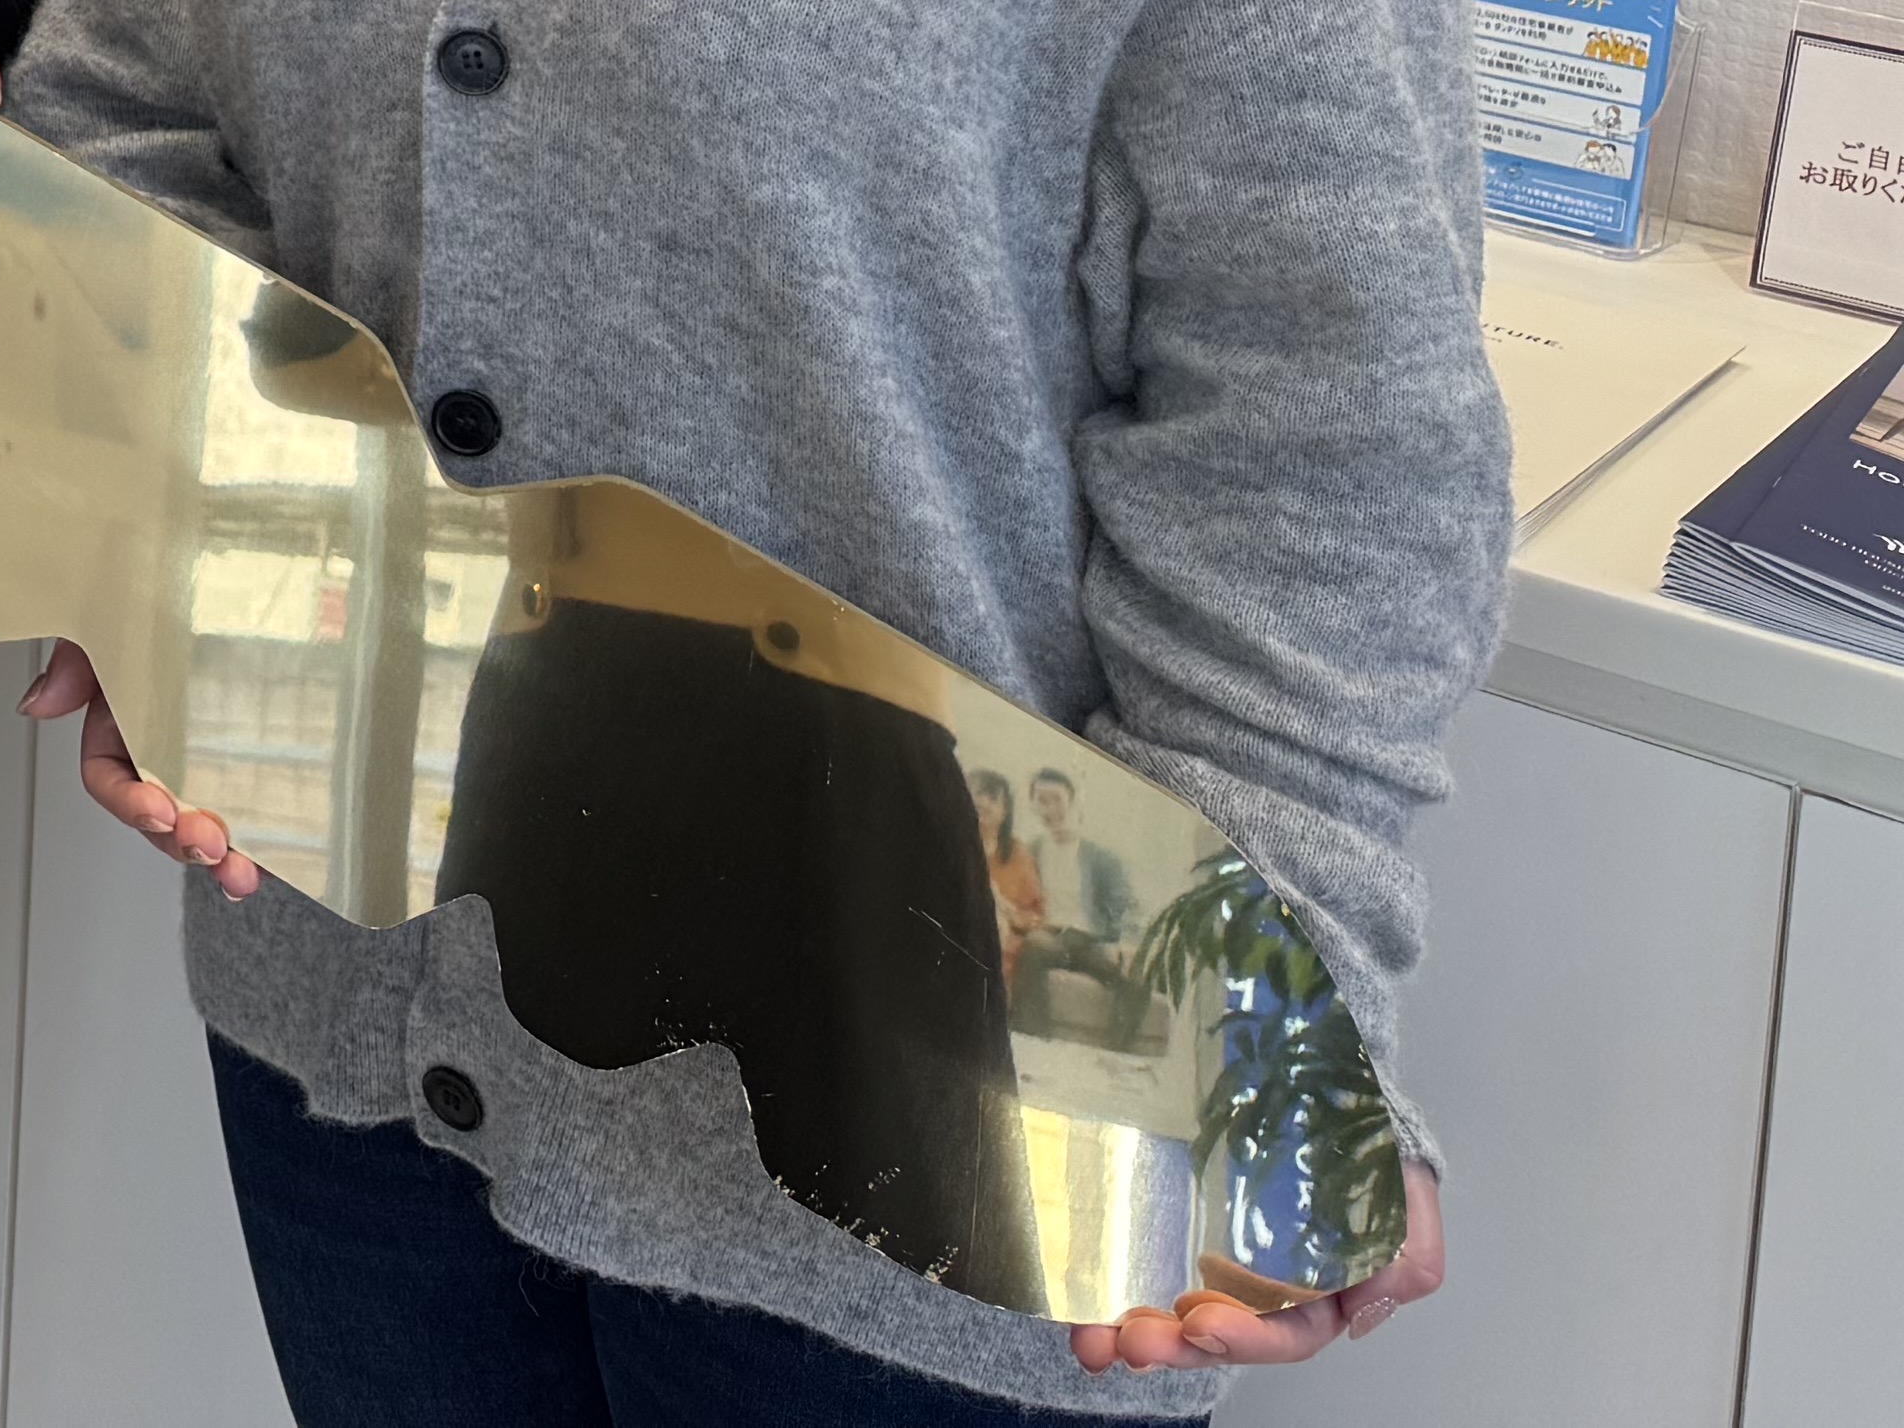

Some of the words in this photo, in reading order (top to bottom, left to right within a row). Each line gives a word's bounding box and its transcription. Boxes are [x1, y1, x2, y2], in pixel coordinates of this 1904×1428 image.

[1798, 160, 1904, 204] お取りく
[1852, 459, 1904, 487] HO
